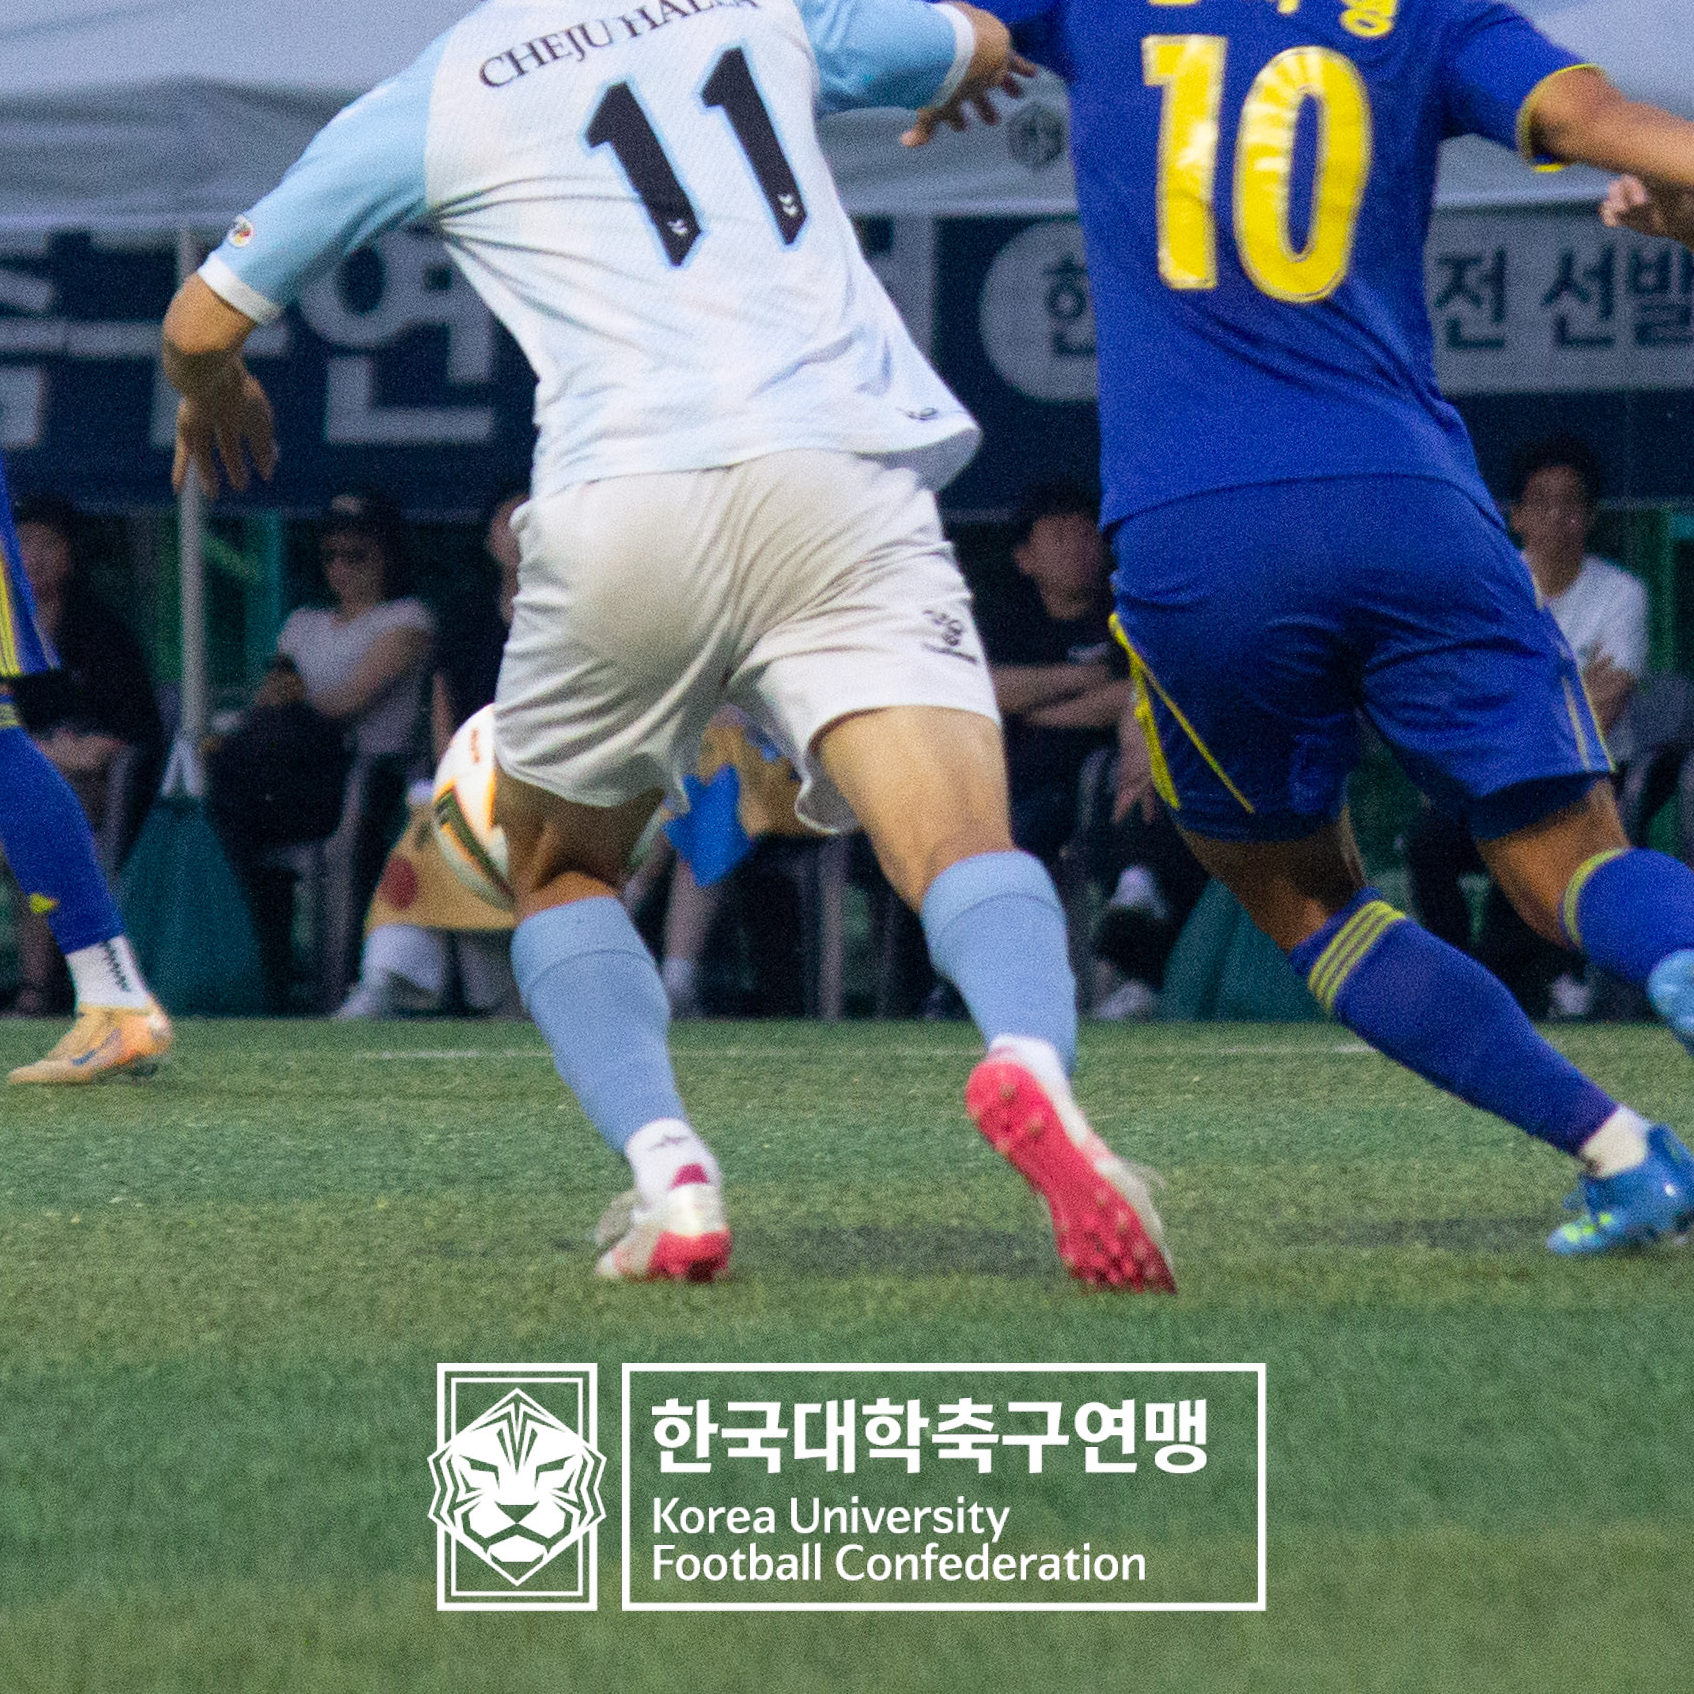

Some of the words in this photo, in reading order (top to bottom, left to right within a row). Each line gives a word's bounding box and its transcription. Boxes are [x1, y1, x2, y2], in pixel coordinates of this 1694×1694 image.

[478, 19, 614, 89] CHEJU
[583, 42, 808, 268] 11
[1140, 33, 1374, 305] 10
